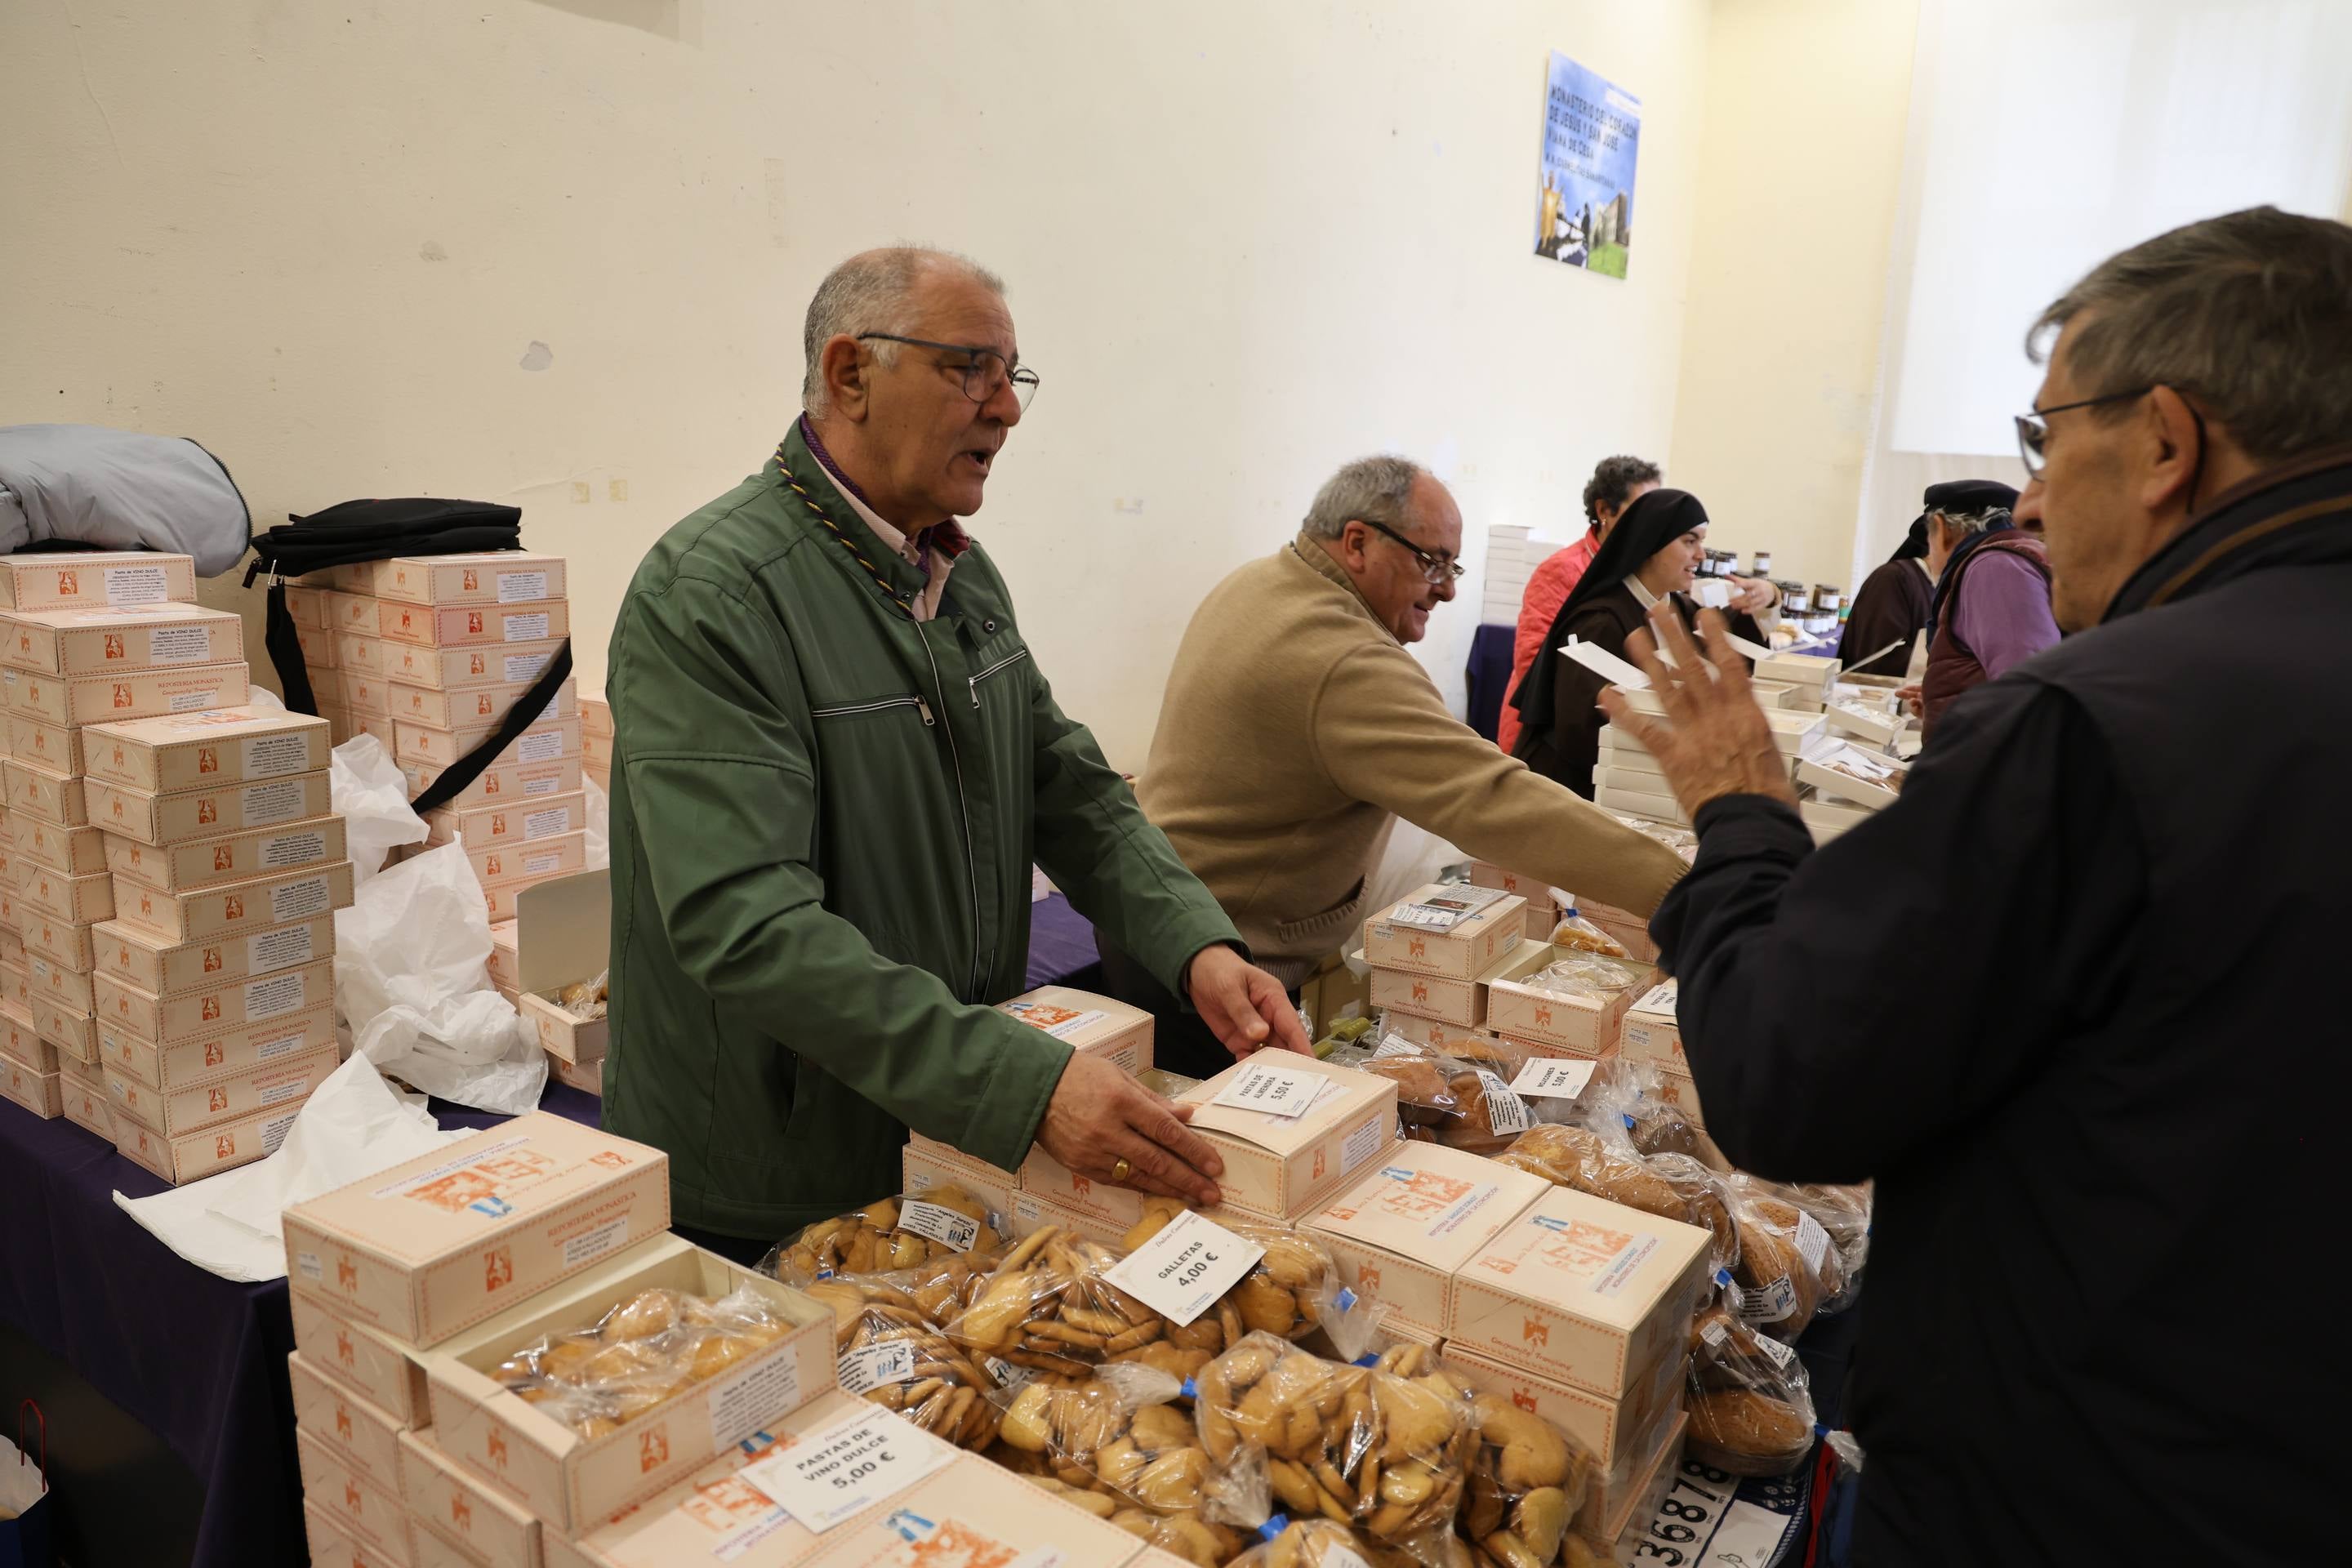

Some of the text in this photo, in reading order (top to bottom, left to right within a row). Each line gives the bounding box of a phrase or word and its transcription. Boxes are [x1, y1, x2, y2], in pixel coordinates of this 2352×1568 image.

[1549, 105, 1559, 124] DE
[1588, 124, 1601, 144] SAN
[1569, 137, 1577, 154] DE
[1239, 1080, 1258, 1097] PASTAS
[1254, 1076, 1276, 1099] ALMENDRA
[1271, 1086, 1290, 1100] 5,50
[1552, 1076, 1566, 1087] 5,00
[919, 1227, 944, 1241] VALLADOLID
[1158, 1241, 1204, 1280] GALLETAS
[1178, 1251, 1219, 1287] 4,00 €
[795, 1428, 874, 1471] PASTAS DE
[804, 1434, 889, 1482] VINO DULCE
[831, 1450, 895, 1489] 5,00 €
